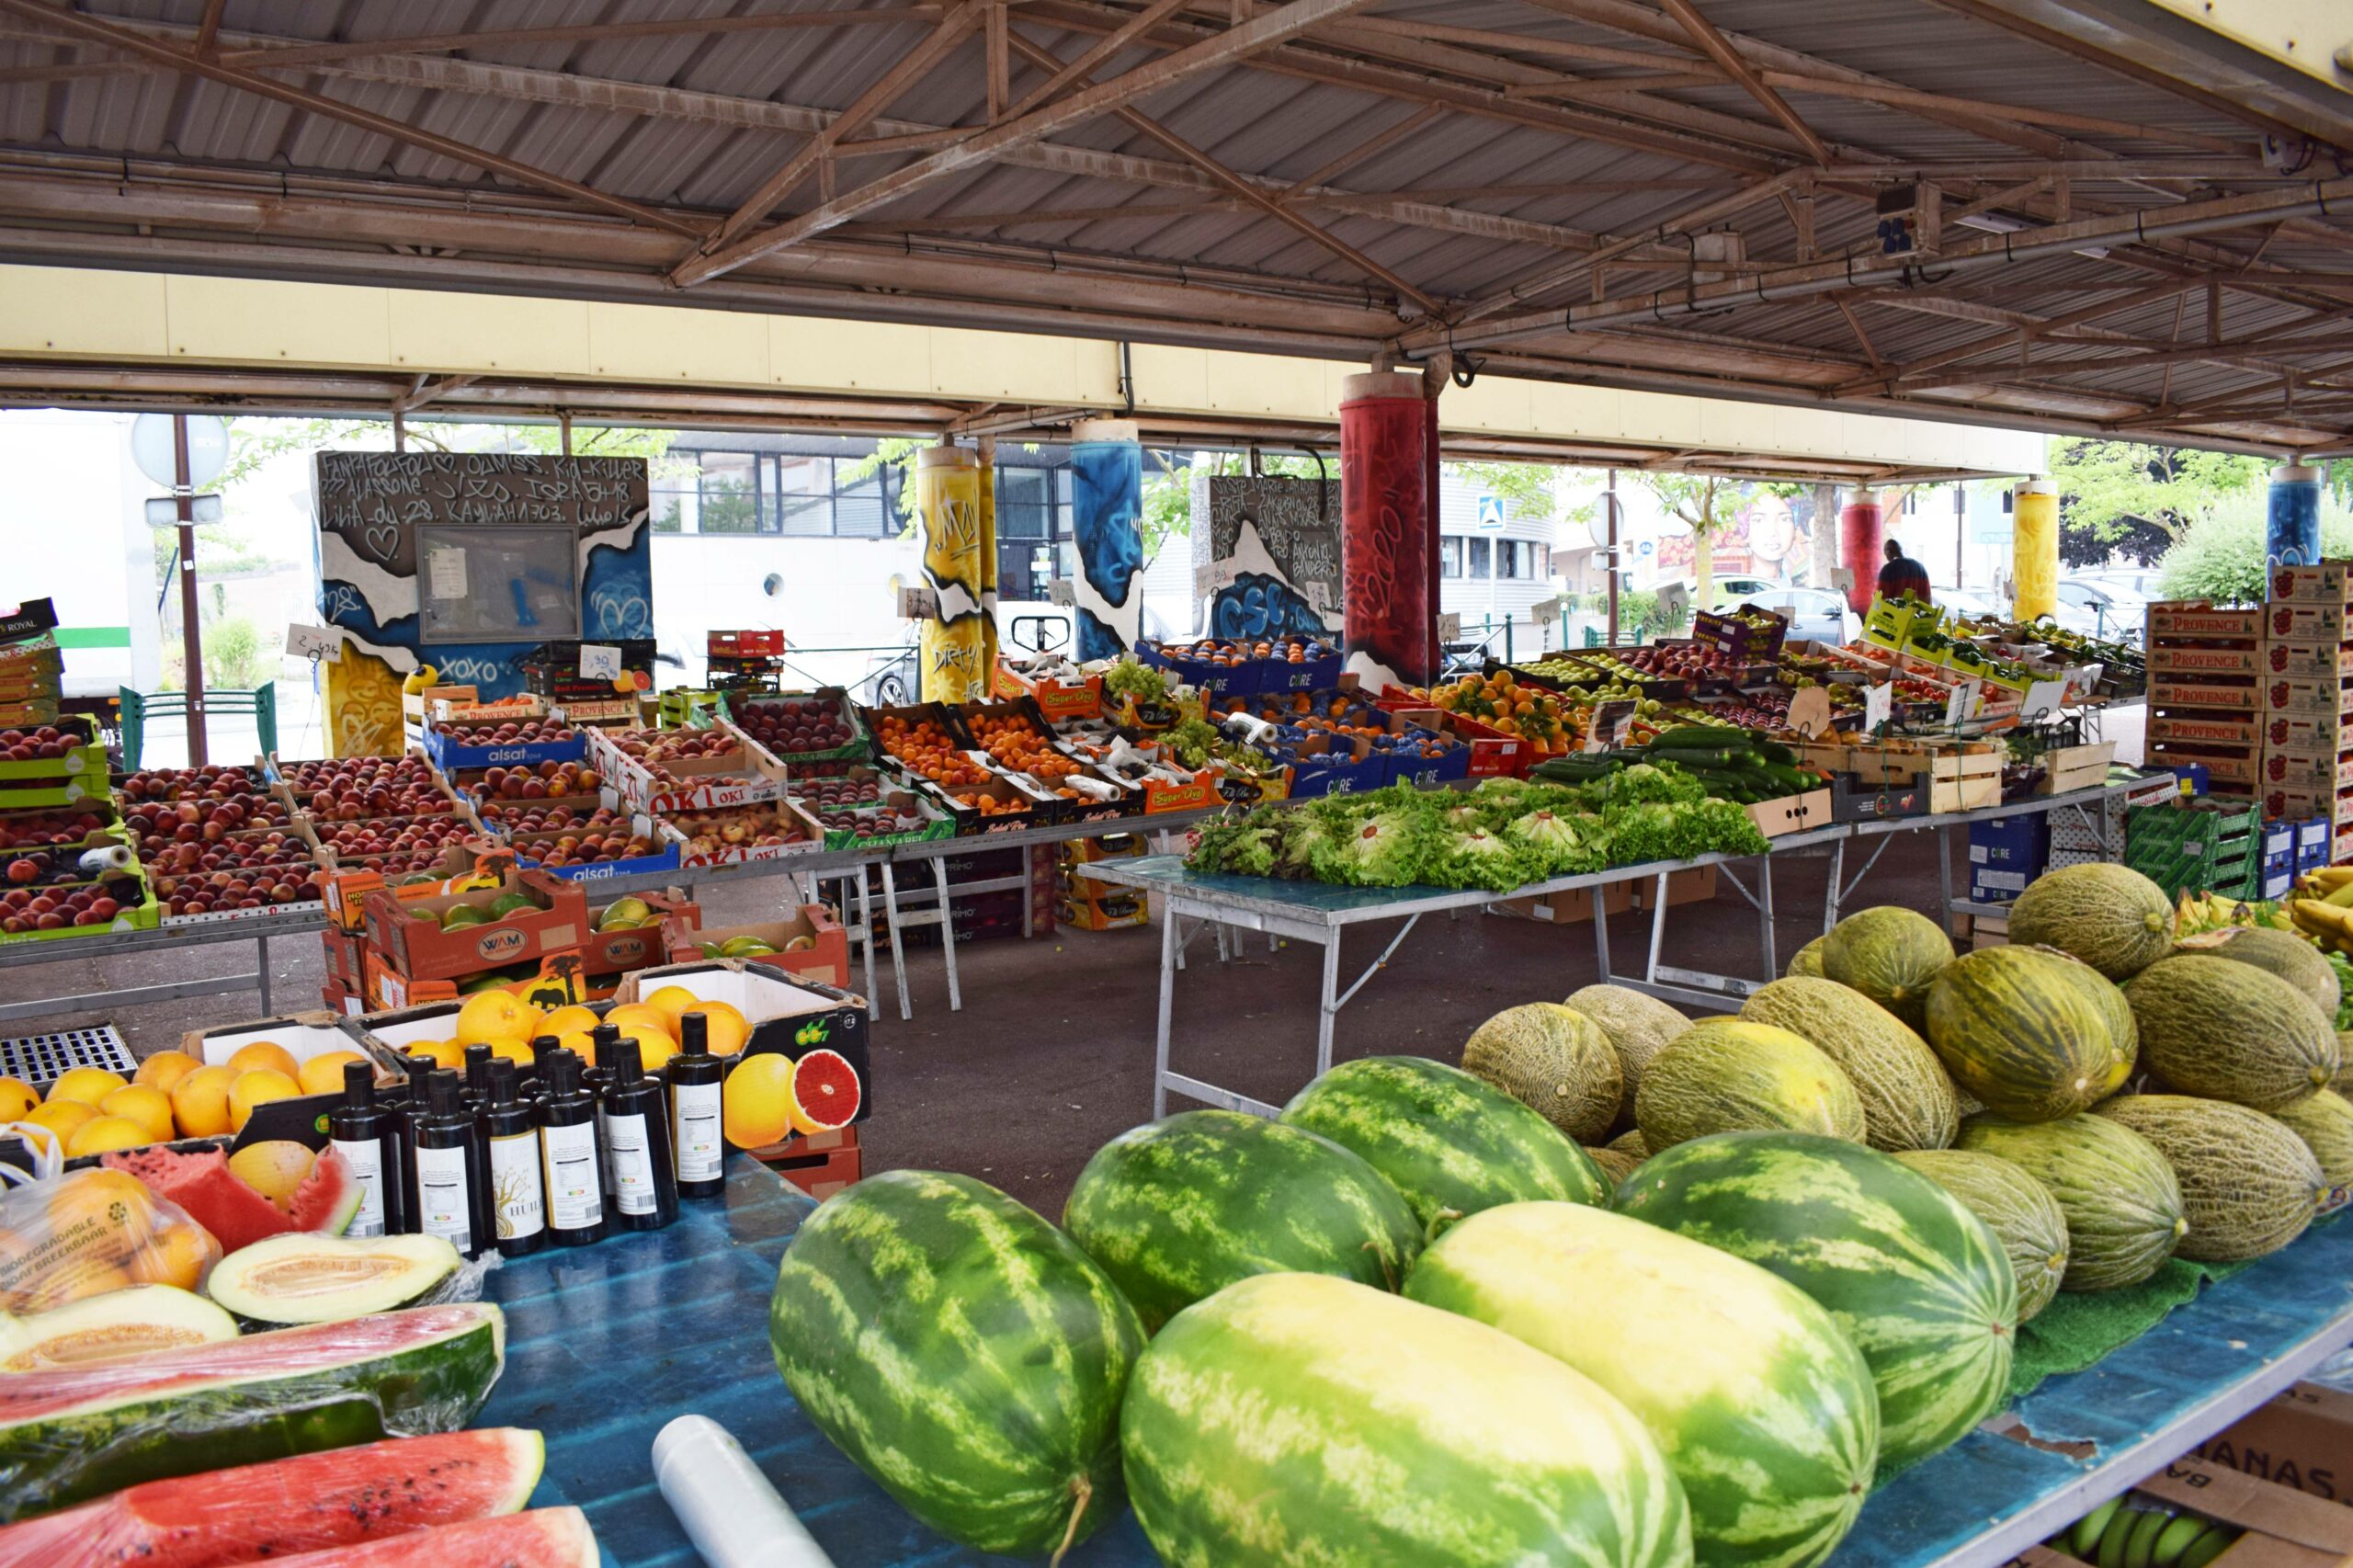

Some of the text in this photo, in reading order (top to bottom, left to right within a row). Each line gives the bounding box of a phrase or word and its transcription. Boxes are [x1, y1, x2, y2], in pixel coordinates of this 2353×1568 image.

[7, 619, 38, 632] ROYAL
[2173, 617, 2241, 632] PROVENCE
[2172, 652, 2239, 667] PROVENCE
[438, 655, 498, 682] XOXO
[2173, 687, 2239, 703] PROVENCE
[573, 705, 622, 716] PROVENCE
[2172, 722, 2238, 739] PROVENCE
[488, 748, 528, 763] alsat
[719, 789, 745, 804] OKI
[574, 864, 614, 881] alsat
[483, 934, 520, 950] WAM
[609, 942, 642, 955] WAM
[2200, 1440, 2336, 1499] ANAS
